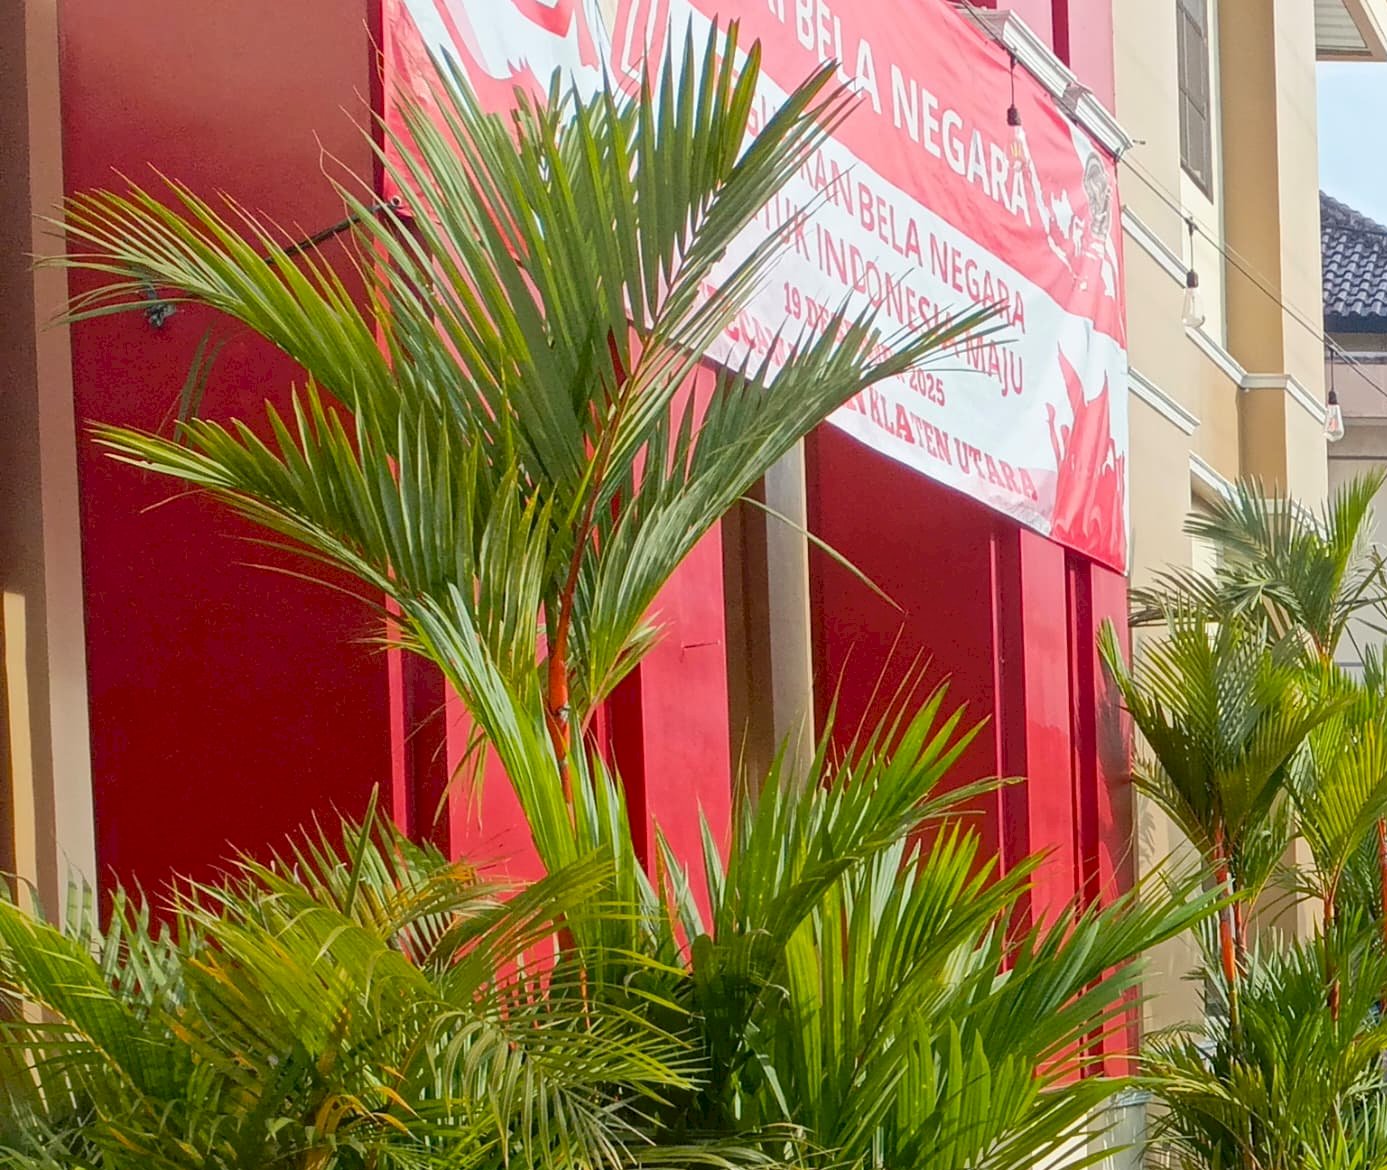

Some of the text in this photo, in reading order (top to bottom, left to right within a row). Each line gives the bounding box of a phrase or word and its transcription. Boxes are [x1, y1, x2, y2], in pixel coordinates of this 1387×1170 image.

[796, 0, 882, 115] BELA
[891, 63, 1032, 227] NEGARA
[858, 182, 1026, 334] BELA NEGARA
[783, 281, 802, 320] 19
[909, 368, 945, 407] 2025
[964, 326, 1023, 397] MAJU
[868, 387, 953, 466] KLATEN
[954, 437, 1038, 501] UTARA
